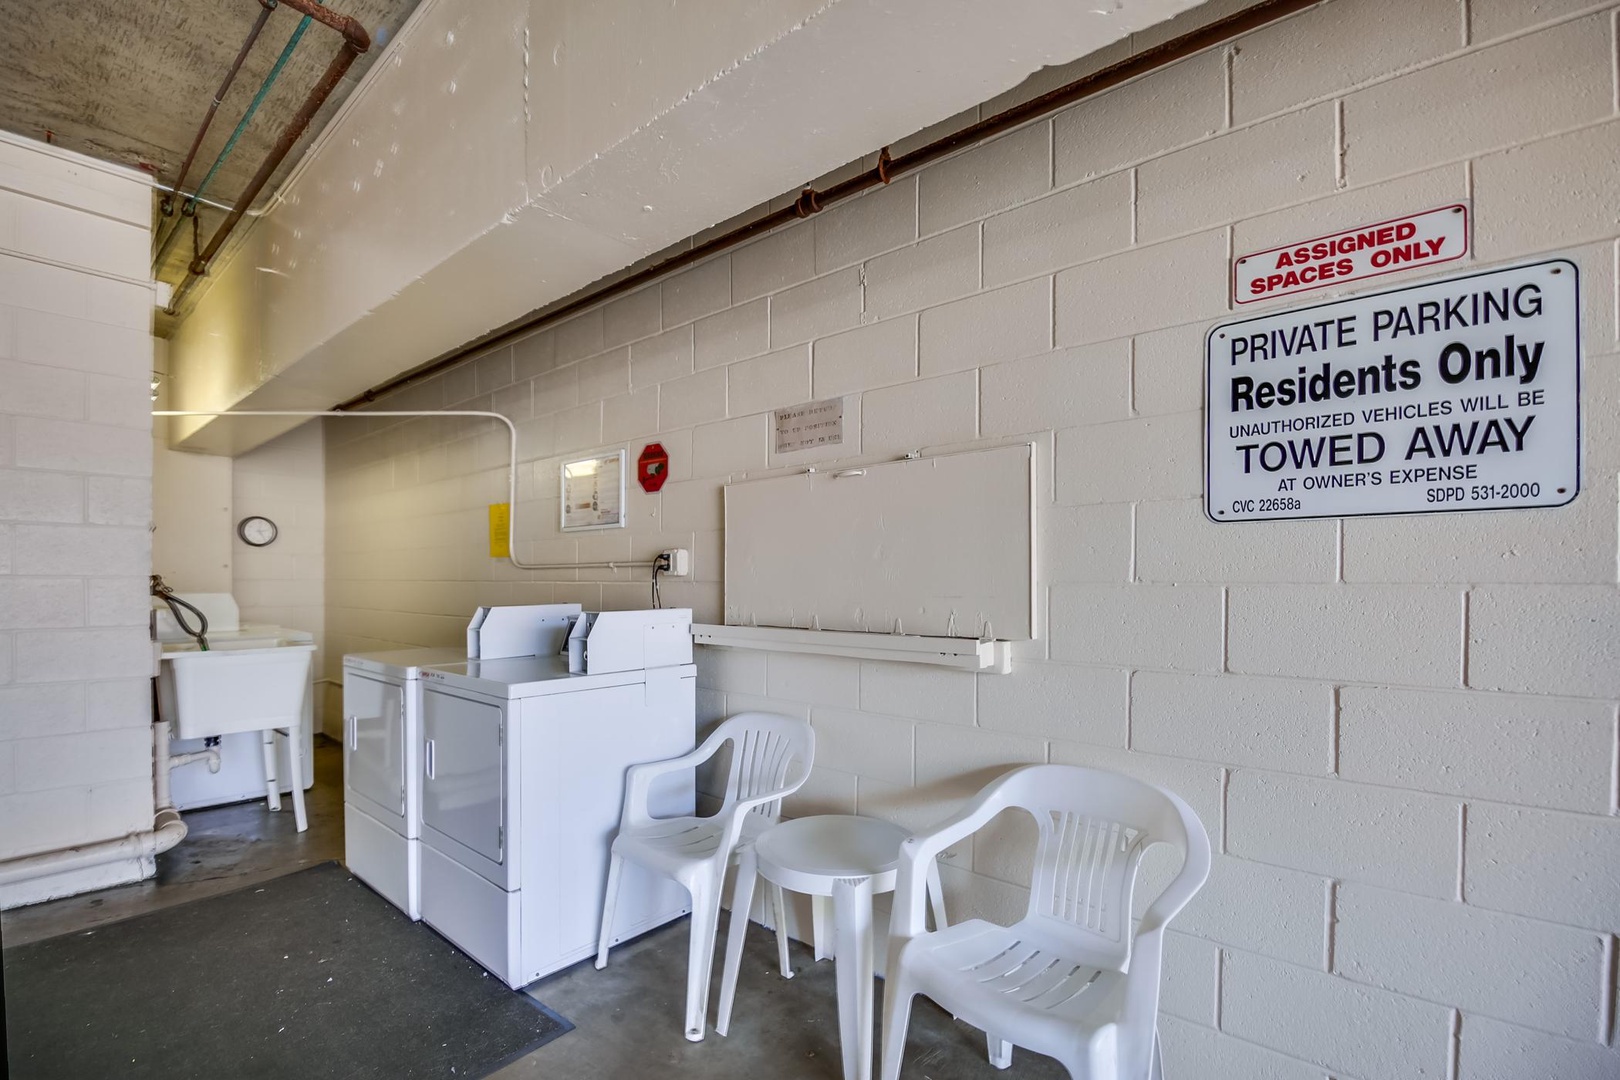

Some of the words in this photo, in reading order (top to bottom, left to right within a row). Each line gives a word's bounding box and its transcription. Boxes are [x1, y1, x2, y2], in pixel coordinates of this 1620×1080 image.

[1250, 258, 1354, 295] SPACES
[1370, 237, 1446, 269] ONLY
[1275, 222, 1417, 269] ASSIGNED
[1231, 315, 1357, 366] PRIVATE
[1373, 283, 1543, 342] PARKING
[1231, 354, 1421, 412] Residents
[1439, 335, 1545, 385] Only
[1229, 412, 1355, 439] UNAUTHORIZED
[1362, 401, 1452, 424] VEHICLES
[1460, 394, 1508, 413] WILL
[1517, 389, 1545, 407] BE
[1236, 431, 1385, 474] TOWED
[1405, 415, 1536, 460] AWAY
[1277, 478, 1296, 492] AT
[1303, 471, 1382, 490] OWNER'S
[1390, 464, 1478, 485] EXPENSE
[1426, 488, 1465, 503] SDPD
[1471, 482, 1540, 500] 531-2000
[1232, 500, 1254, 513] CVC
[1259, 497, 1301, 512] 22658a
